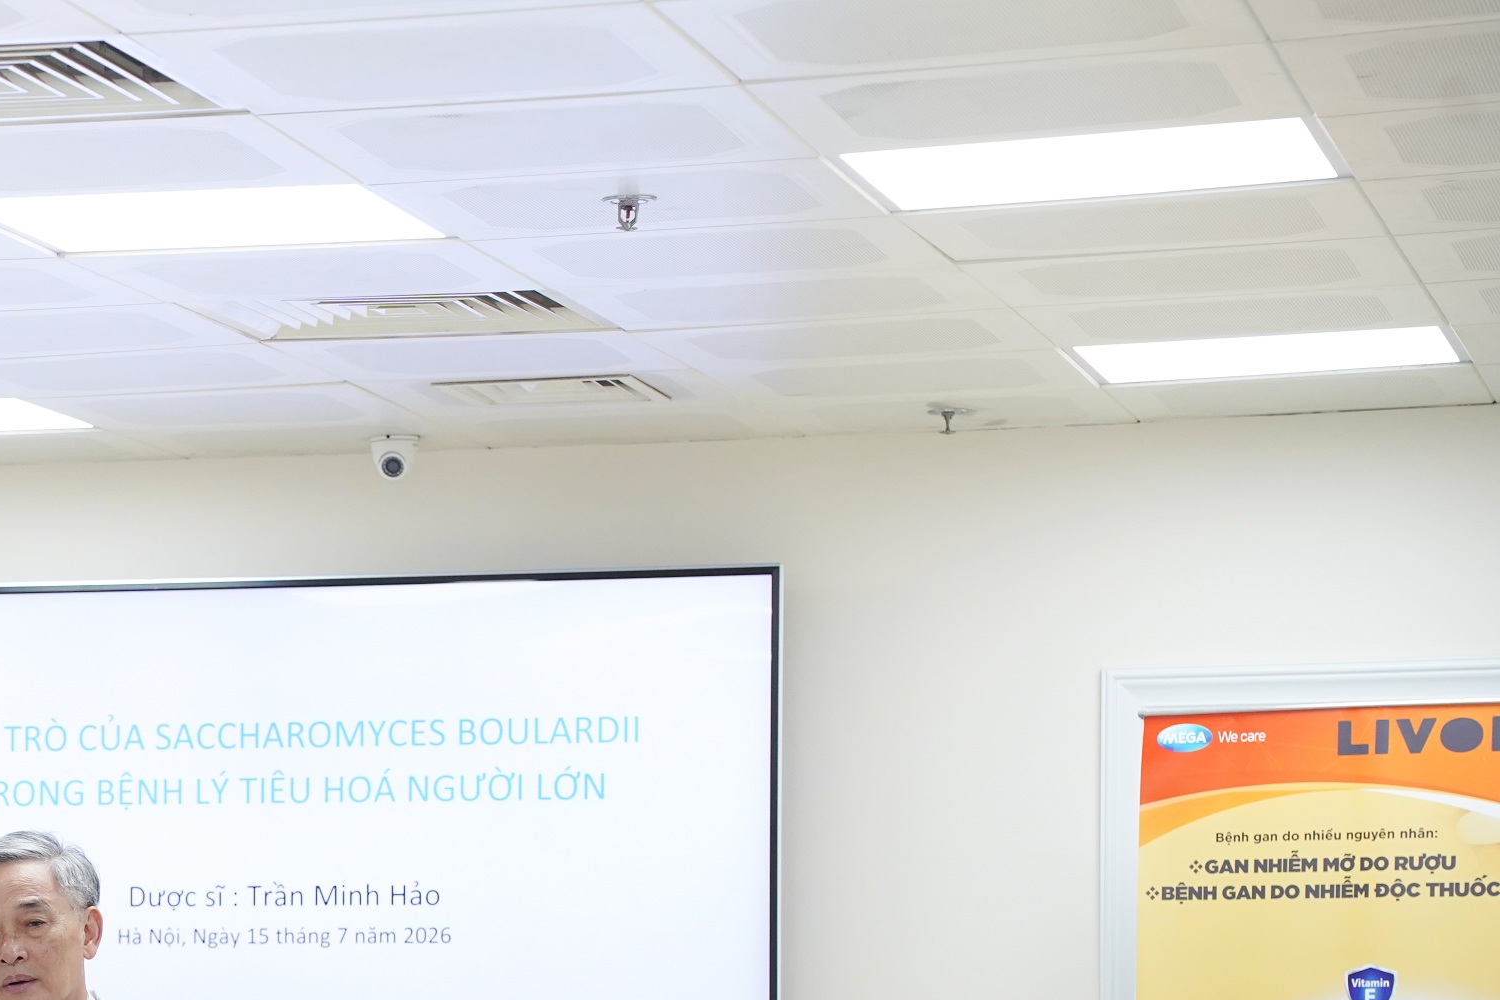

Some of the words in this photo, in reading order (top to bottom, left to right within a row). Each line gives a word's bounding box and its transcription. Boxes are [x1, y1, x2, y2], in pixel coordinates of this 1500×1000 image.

[4, 719, 68, 753] TRÒ
[79, 714, 145, 752] CỦA
[155, 719, 446, 751] SACCHAROMYCES
[458, 716, 640, 746] BOULARDII
[1163, 732, 1207, 744] MEGA
[1218, 731, 1238, 743] We
[1240, 731, 1266, 742] care
[1337, 716, 1500, 756] LIVO
[99, 772, 183, 810] BỆNH
[196, 770, 230, 805] LÝ
[239, 769, 311, 805] TIÊU
[324, 769, 396, 804] HOÁ
[407, 766, 524, 803] NGƯỜI
[537, 765, 606, 801] LỚN
[1216, 832, 1249, 846] Bệnh
[1254, 833, 1278, 844] gan
[1282, 831, 1299, 841] do
[1346, 828, 1395, 842] nguyên
[1400, 828, 1438, 839] nhân:
[1204, 859, 1248, 874] GAN
[1254, 850, 1318, 873] NHIỄM
[1323, 853, 1355, 872] MỠ
[1360, 856, 1389, 871] DO
[1394, 853, 1457, 875] RƯỢU
[130, 886, 196, 911] Dược
[206, 885, 225, 907] sĩ
[248, 881, 304, 906] Trần
[314, 884, 380, 906] Minh
[390, 881, 441, 906] Hảo
[1161, 882, 1217, 904] BỆNH
[1222, 885, 1266, 900] GAN
[1270, 884, 1300, 899] DO
[1305, 875, 1370, 899] NHIỄM
[1374, 878, 1421, 902] ĐỘC
[1426, 874, 1500, 898] THUỐC
[118, 927, 142, 945] Hà
[149, 927, 186, 948] Nội,
[193, 928, 240, 949] Ngày
[248, 928, 270, 945] 15
[276, 927, 331, 949] tháng
[338, 927, 347, 944] 7
[355, 926, 397, 944] năm
[404, 926, 452, 944] 2026
[1351, 978, 1390, 988] Vitamin
